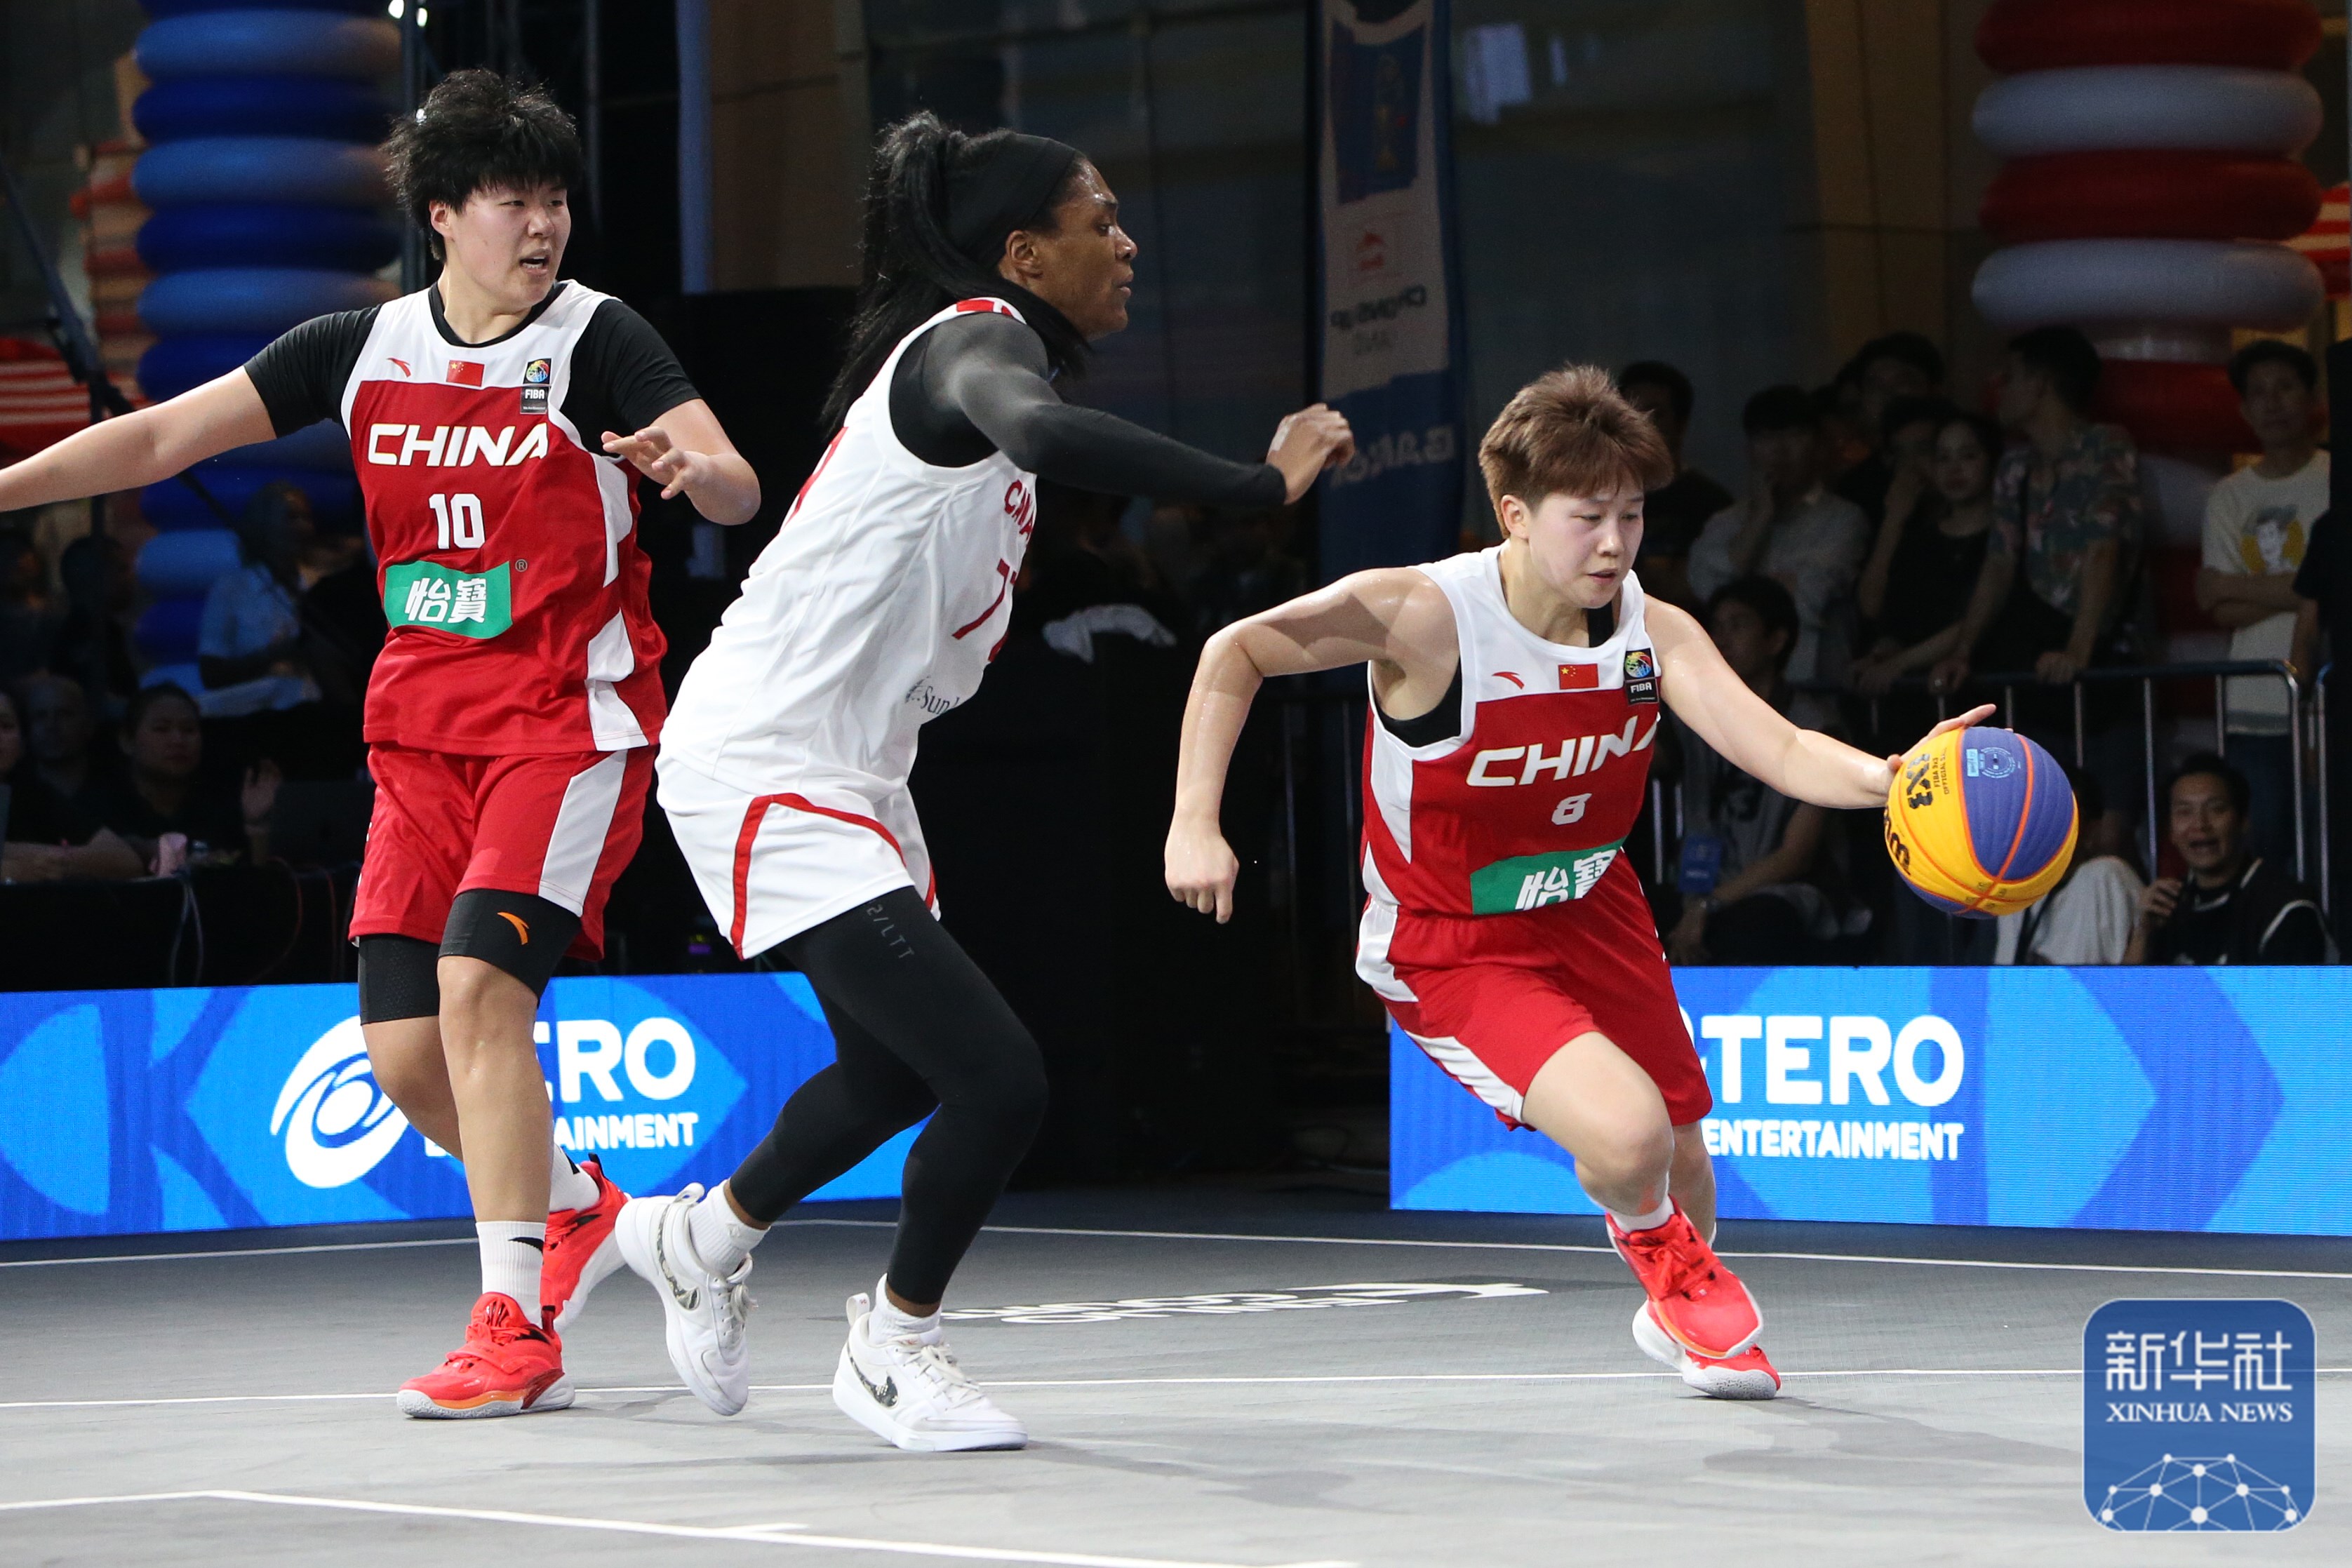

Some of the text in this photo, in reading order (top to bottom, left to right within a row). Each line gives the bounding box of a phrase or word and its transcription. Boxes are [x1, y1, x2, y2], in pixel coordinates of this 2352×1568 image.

[525, 389, 545, 399] FIBA
[368, 422, 549, 467] CHINA
[429, 492, 486, 549] 10
[405, 577, 487, 624] 怡寶
[1630, 682, 1652, 693] FIBA
[1679, 1006, 1964, 1106] TERO
[1701, 1118, 1964, 1161] ENTERTAINMENT
